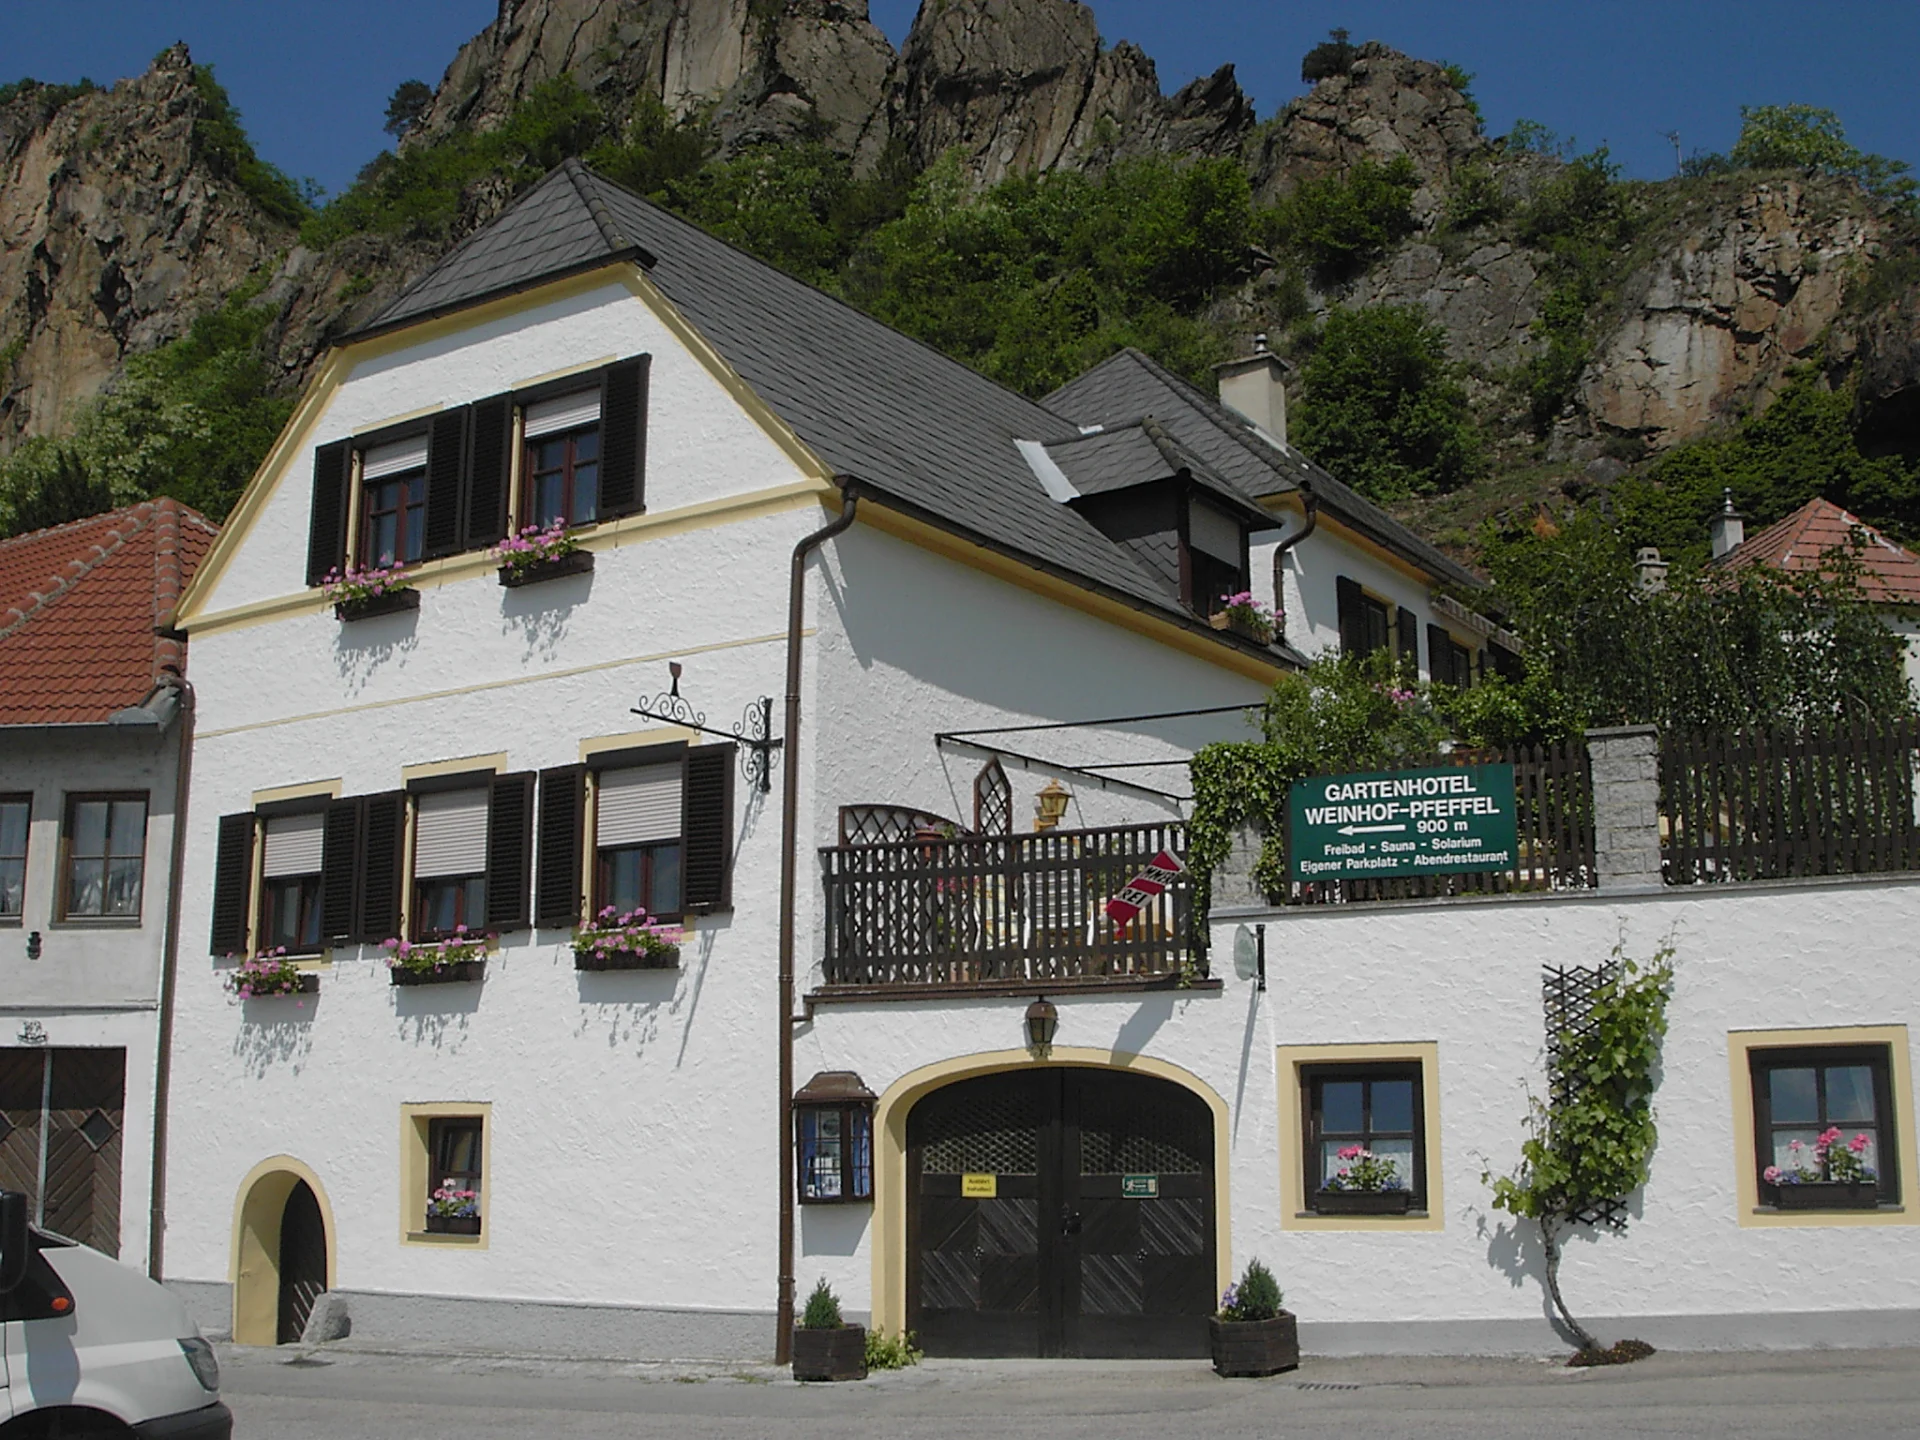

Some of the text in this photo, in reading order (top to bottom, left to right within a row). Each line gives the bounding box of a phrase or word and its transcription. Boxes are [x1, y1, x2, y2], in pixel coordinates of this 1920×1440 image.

[1324, 775, 1477, 802] GARTENHOTEL
[1304, 797, 1501, 826] WEINHOF-PFEFFEL
[1416, 818, 1469, 834] 900 m
[1324, 842, 1366, 856] Freibad
[1380, 840, 1416, 853] Sauna
[1431, 837, 1482, 850] Solarium
[1300, 860, 1342, 875] Eigener
[1346, 857, 1398, 871] Parkplatz
[1413, 851, 1509, 866] Abendrestaurant
[1122, 889, 1148, 904] REI
